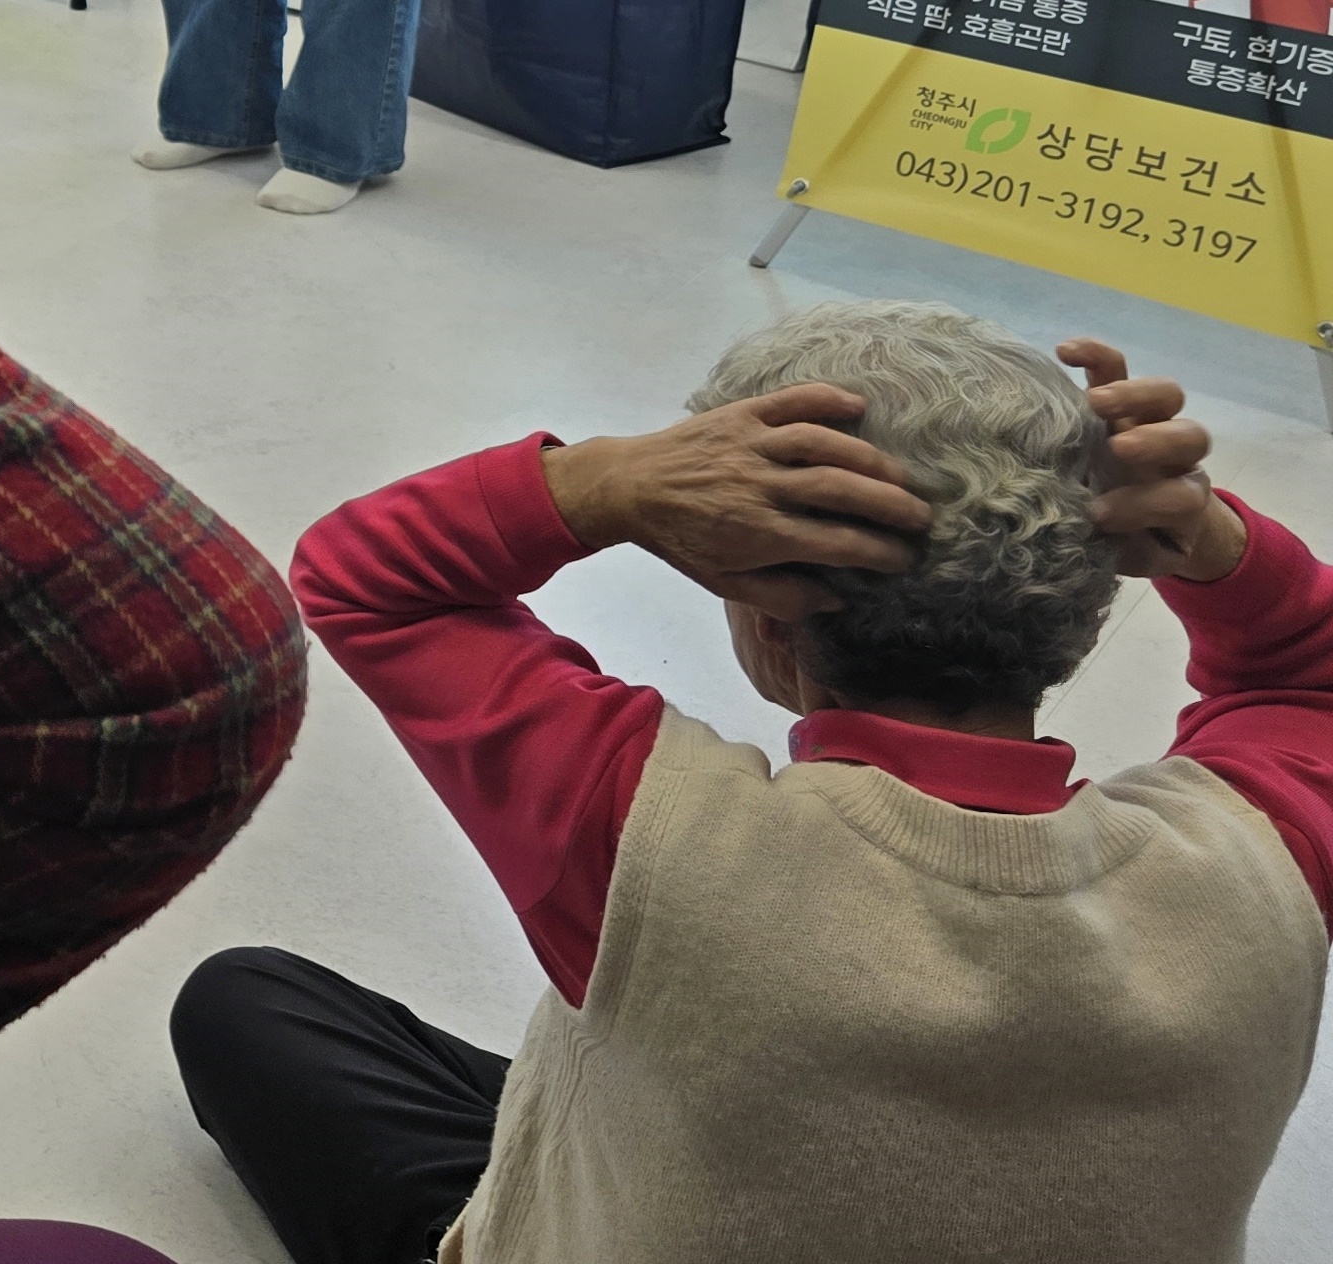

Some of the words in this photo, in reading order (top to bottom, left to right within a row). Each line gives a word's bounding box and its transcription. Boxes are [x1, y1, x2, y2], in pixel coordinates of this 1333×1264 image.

[924, 1, 955, 36] 땀,
[960, 10, 1071, 58] 호흡곤란
[1173, 20, 1237, 59] 구토,
[1246, 35, 1333, 75] 현기증
[916, 86, 977, 118] 청주시
[1186, 58, 1308, 107] 통증확산
[909, 119, 934, 132] CITY
[912, 108, 968, 130] CHEONGJU
[1036, 120, 1268, 207] 상당보건소
[895, 149, 1151, 243] 043)201-3192,
[1162, 217, 1258, 266] 3197
